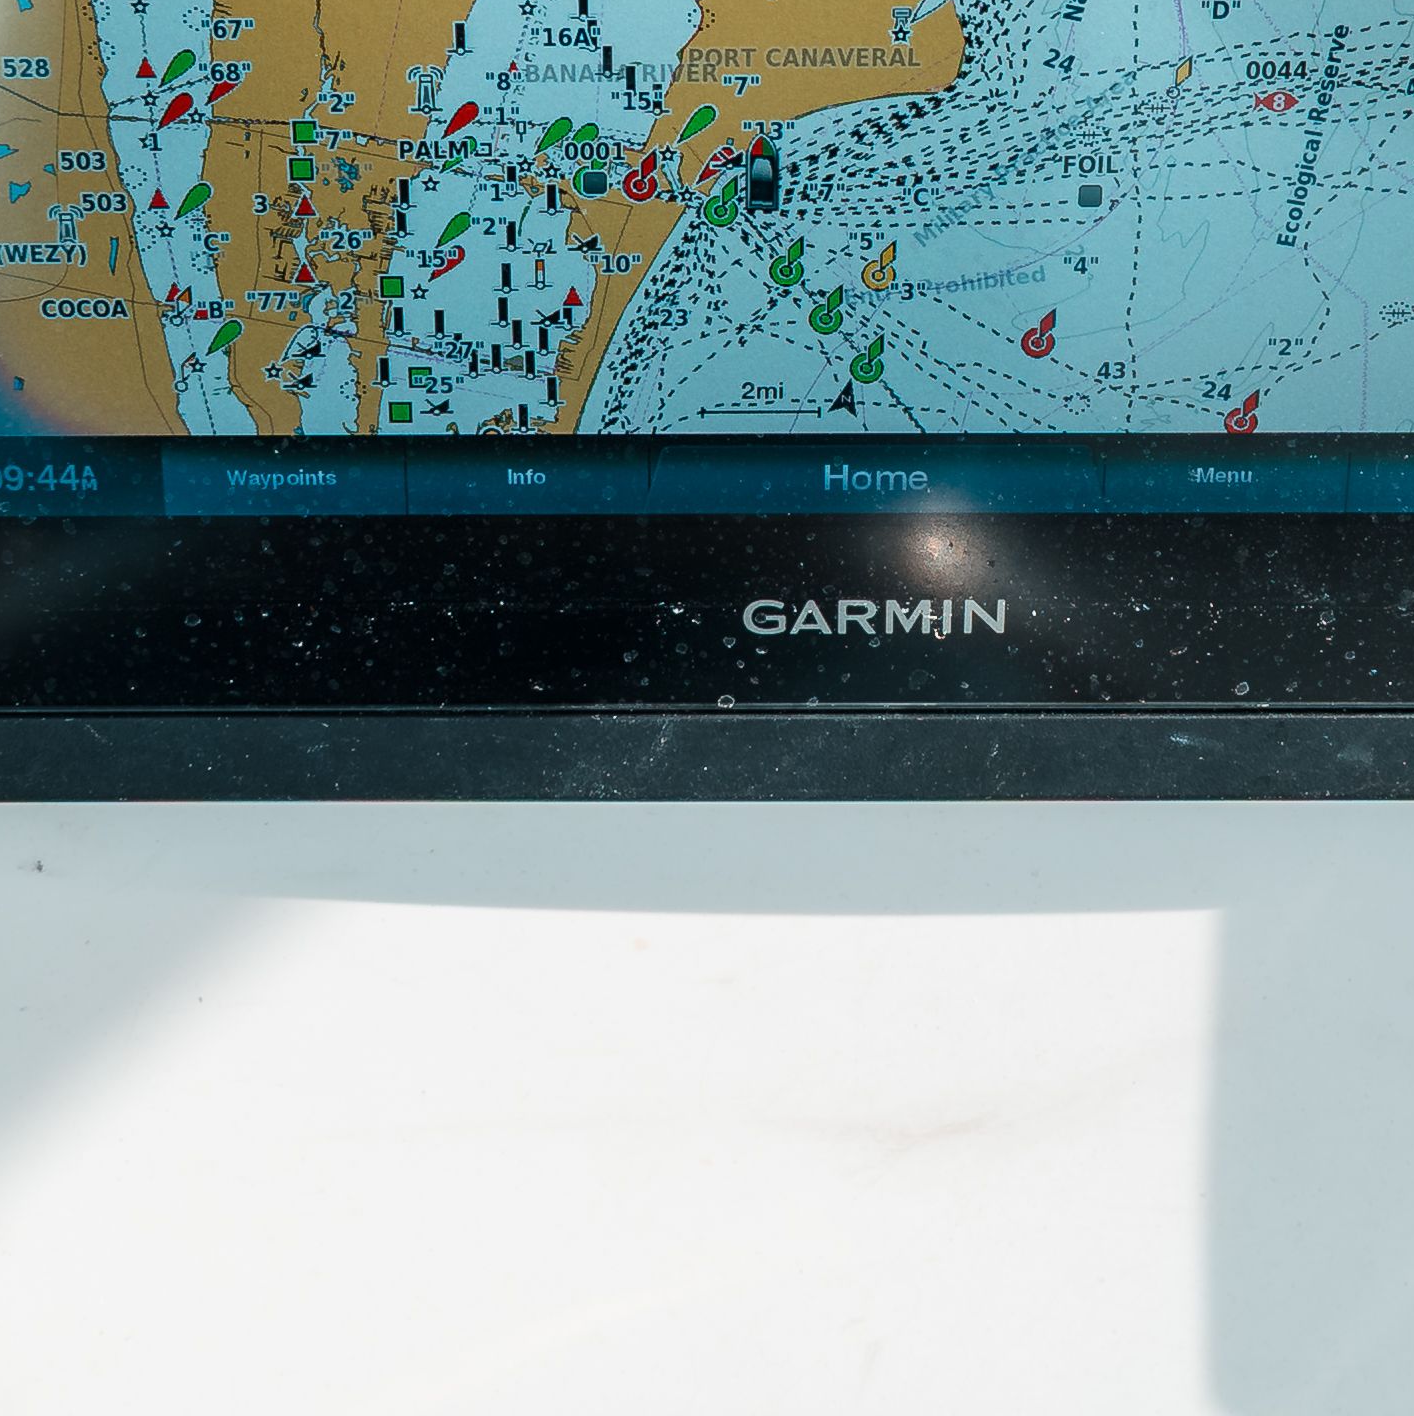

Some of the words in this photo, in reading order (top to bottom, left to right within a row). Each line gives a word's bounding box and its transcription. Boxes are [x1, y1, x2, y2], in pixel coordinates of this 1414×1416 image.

[1202, 1, 1241, 19] "D"
[202, 20, 254, 39] "67"
[531, 28, 601, 46] "16A"
[688, 48, 756, 67] PORT
[766, 48, 921, 67] CANAVERAL
[1043, 48, 1075, 73] 24
[3, 58, 49, 77] 528
[199, 63, 250, 82] "68"
[642, 63, 718, 83] RIVER
[1246, 61, 1308, 79] 0044
[486, 72, 522, 91] "8"
[722, 75, 760, 97] "7"
[319, 94, 354, 113] "2"
[611, 92, 662, 111] "15"
[315, 131, 351, 150] "7"
[1276, 129, 1323, 248] Ecological
[1308, 24, 1350, 123] Reserve
[399, 140, 469, 159] PALM
[564, 142, 625, 160] 0001
[61, 152, 107, 170] 503
[82, 194, 127, 212] 503
[903, 187, 939, 206] "C"
[472, 217, 507, 236] "2"
[193, 234, 229, 252] "C"
[321, 231, 372, 250] "26"
[849, 232, 885, 250] "5"
[406, 249, 457, 269] "15"
[590, 255, 640, 273] "10"
[1064, 257, 1099, 275] "4"
[889, 282, 925, 301] "3"
[42, 300, 128, 318] COCOA
[197, 301, 233, 318] "B"
[247, 292, 299, 311] "77"
[660, 309, 688, 327] 23
[1268, 338, 1303, 356] "2"
[1098, 362, 1125, 379] 43
[414, 376, 464, 394] "25"
[741, 382, 784, 400] 2mi
[1202, 381, 1231, 400] 24
[226, 469, 337, 487] Waypoints
[507, 469, 545, 486] Info
[823, 463, 929, 493] Home
[1196, 467, 1253, 484] Menu
[743, 599, 1007, 636] GARMIN
